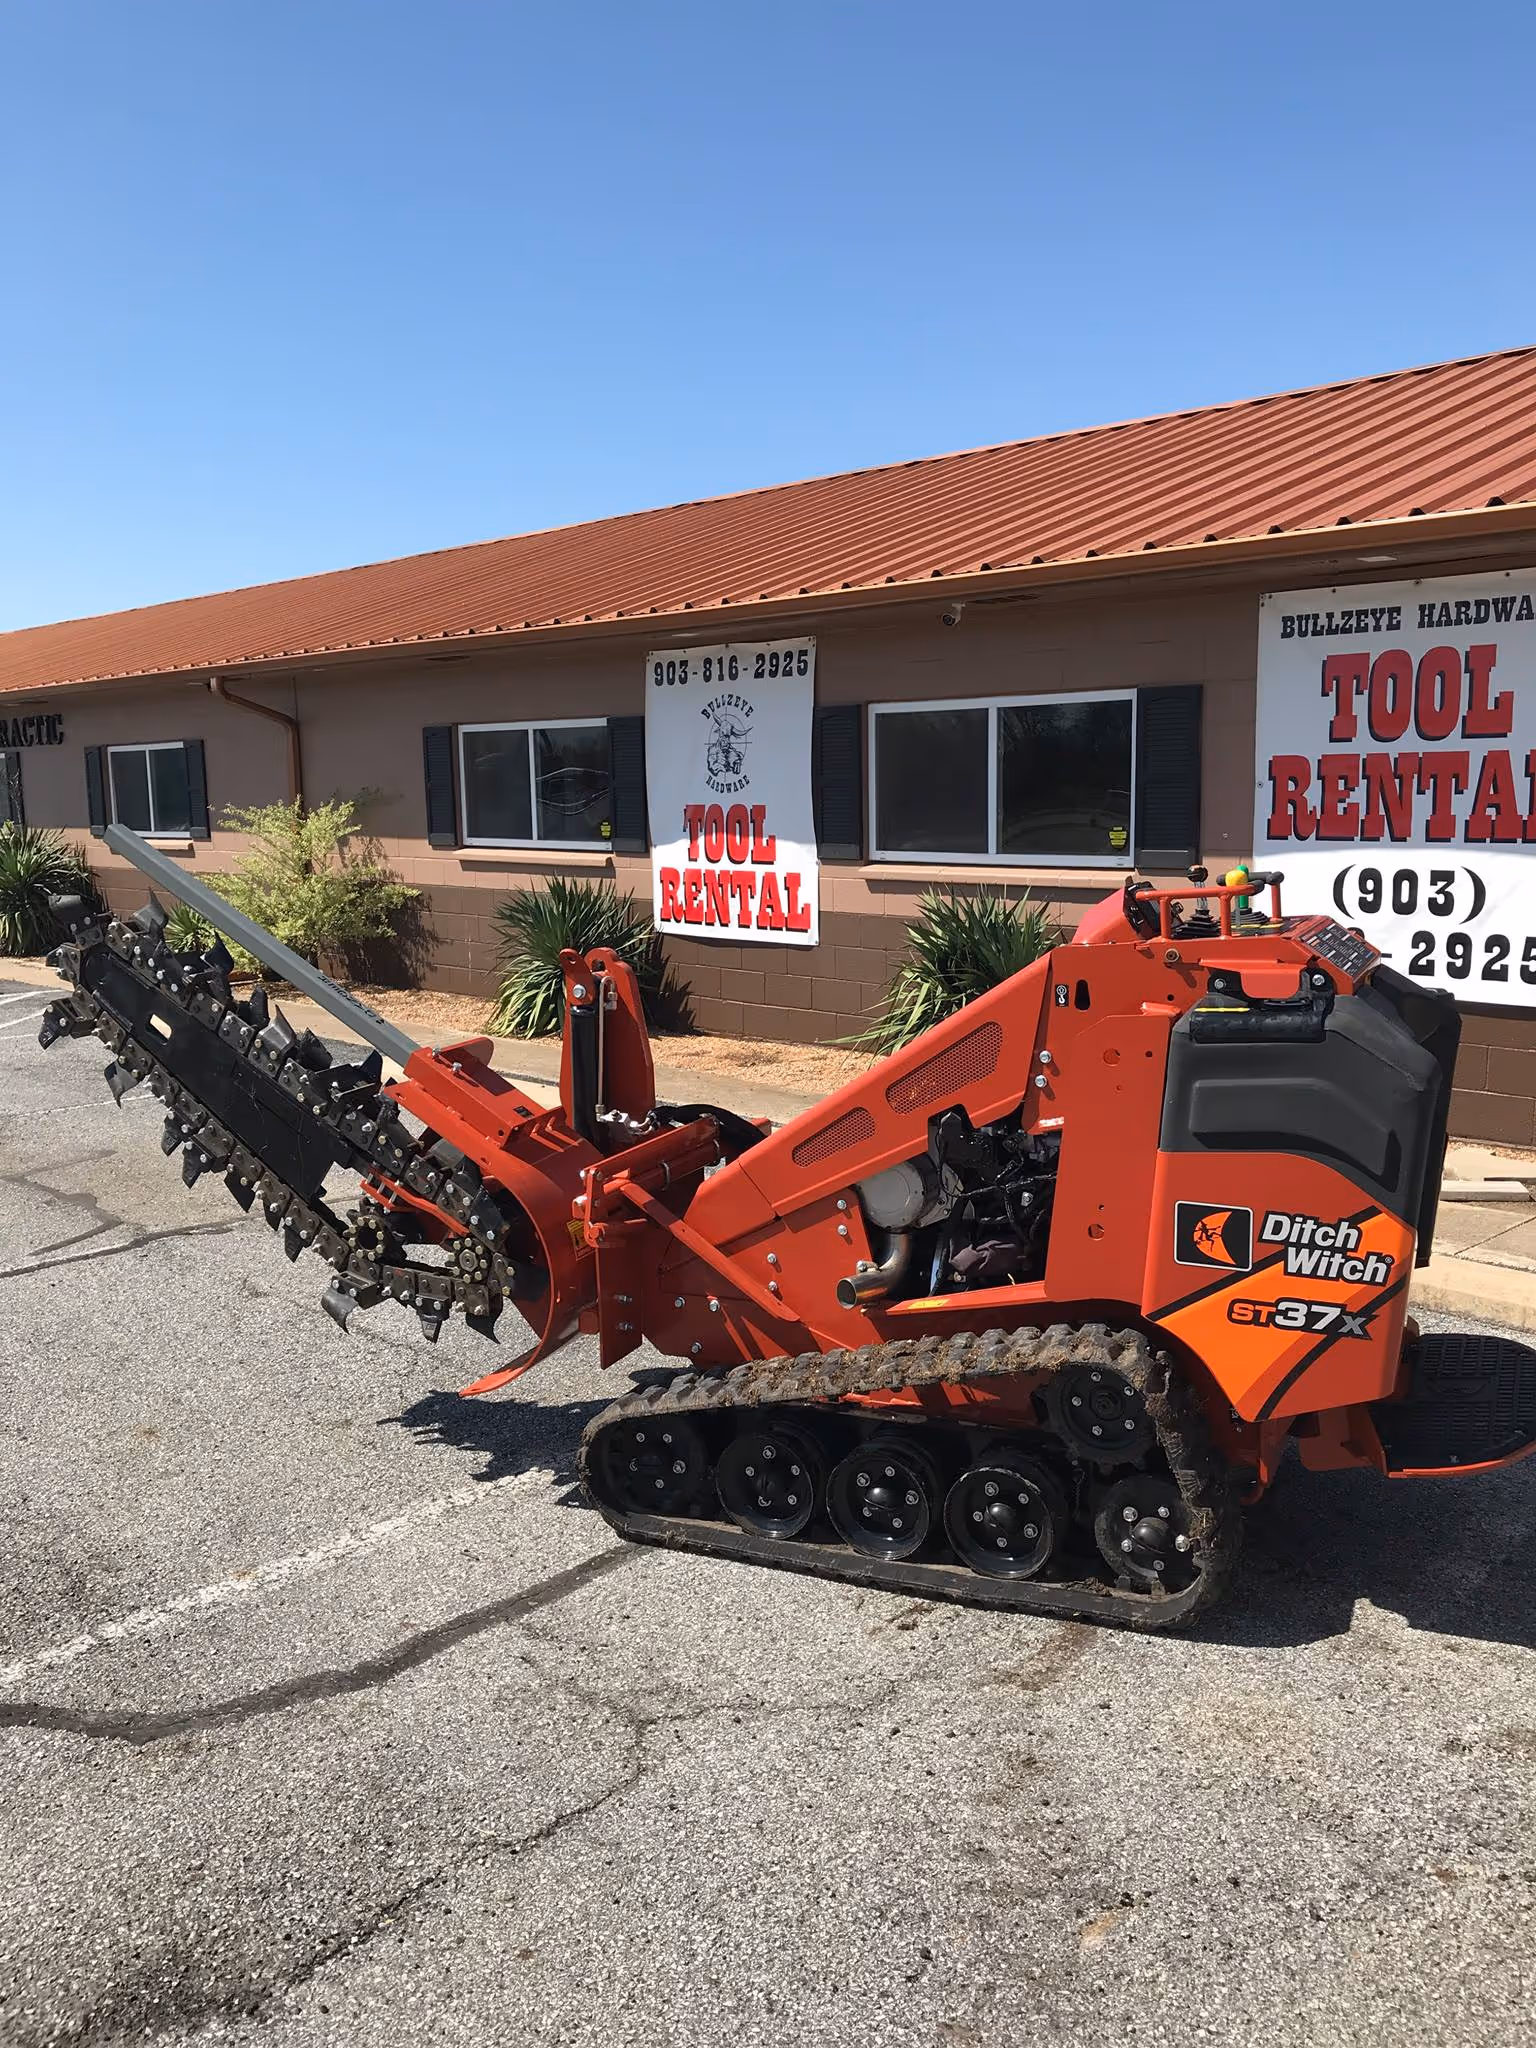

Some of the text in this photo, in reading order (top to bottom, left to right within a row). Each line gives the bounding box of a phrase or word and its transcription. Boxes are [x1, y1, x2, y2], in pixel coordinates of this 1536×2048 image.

[1281, 595, 1535, 639] BULLZEYE HARDWA
[701, 693, 754, 720] BULLZEYE
[1321, 643, 1515, 743] TOOL
[706, 774, 750, 794] HARDWARE
[1267, 749, 1536, 843] RENTA
[683, 803, 776, 865] TOOL
[660, 866, 811, 933] RENTAL
[1332, 863, 1487, 925] (903)
[1261, 1213, 1359, 1249] Ditch
